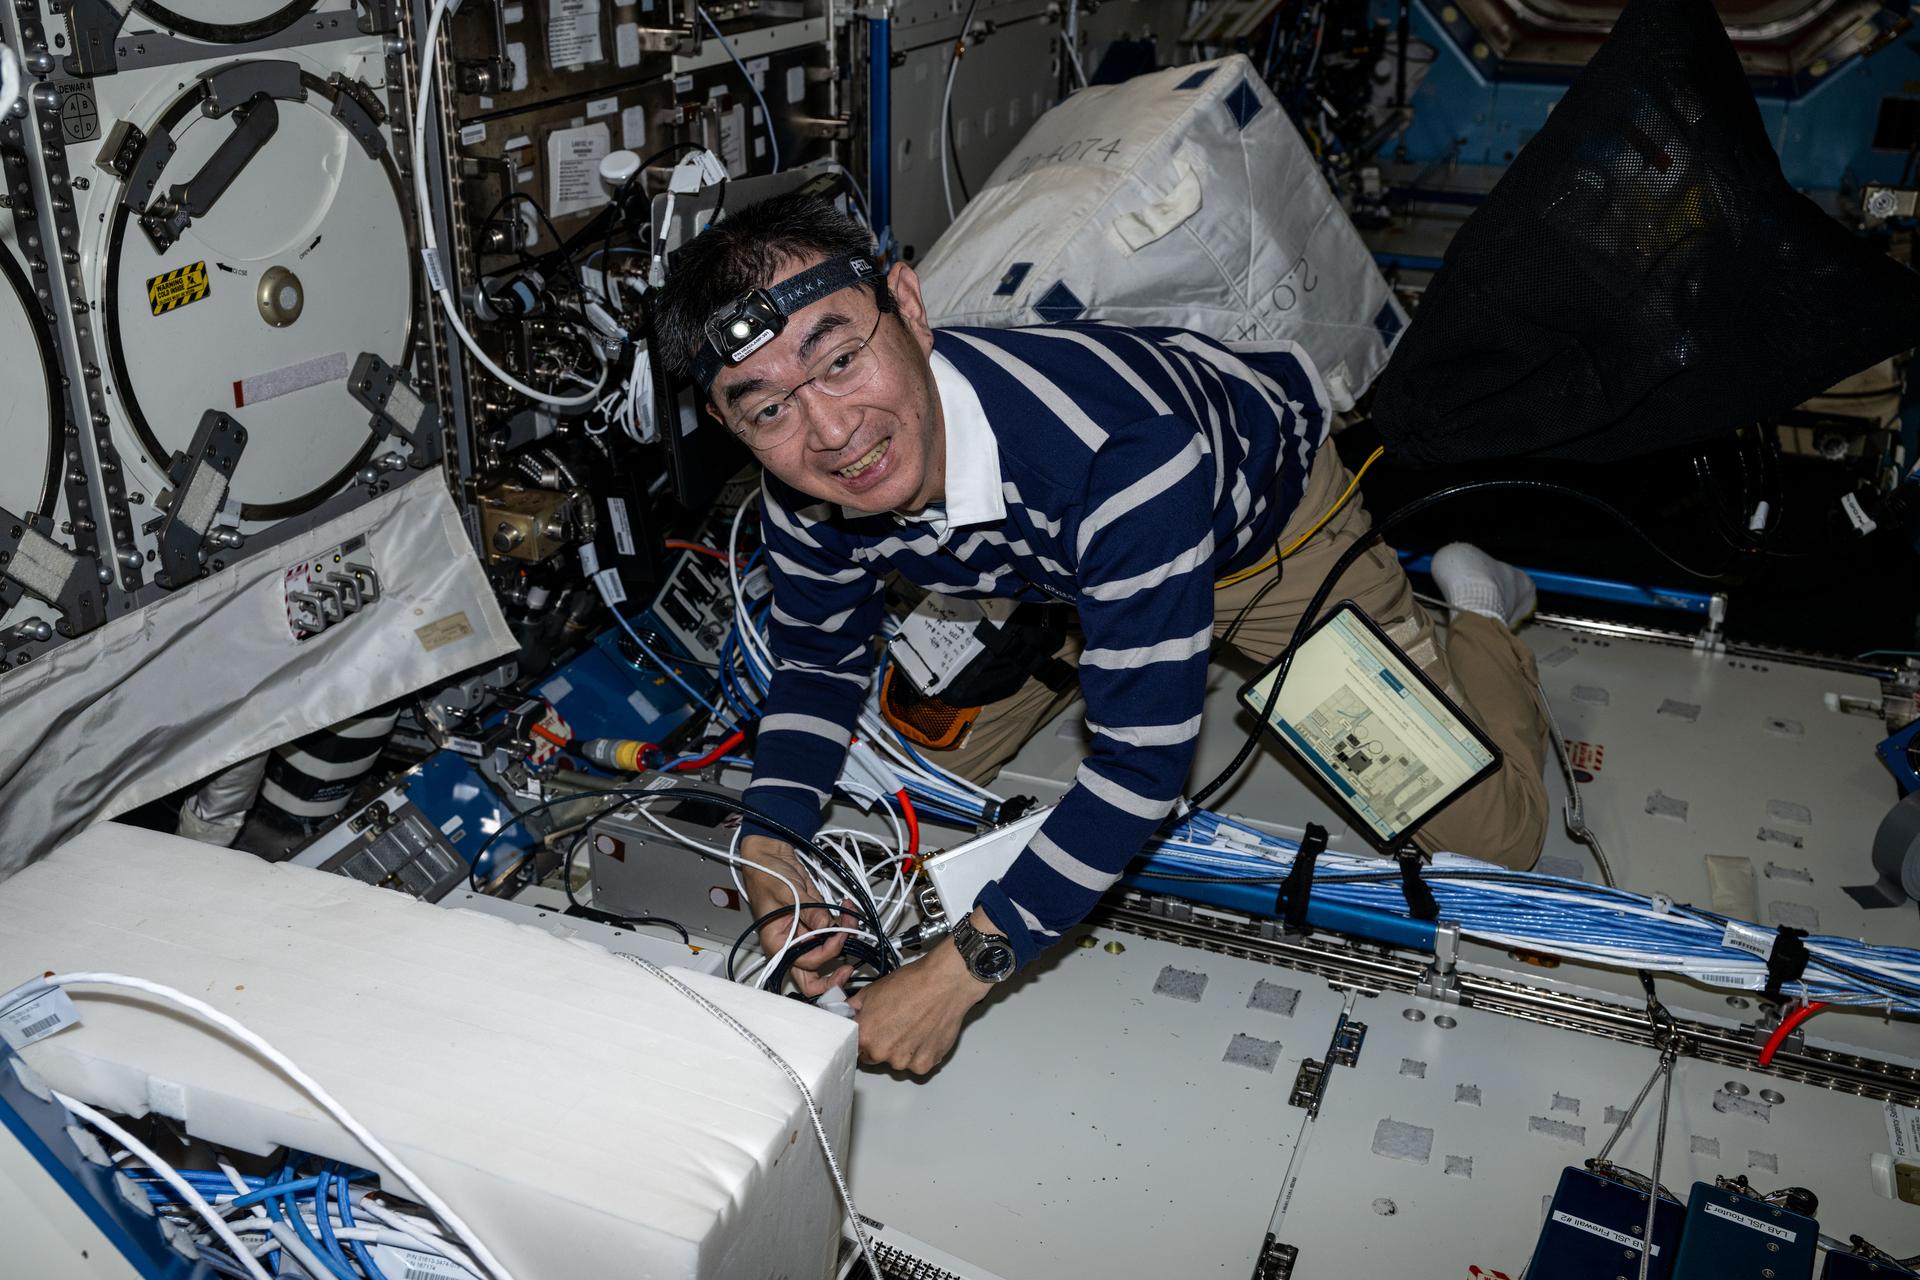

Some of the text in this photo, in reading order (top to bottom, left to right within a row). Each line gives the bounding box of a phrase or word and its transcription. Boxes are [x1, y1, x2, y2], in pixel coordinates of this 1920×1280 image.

[58, 82, 86, 94] DEWAR
[70, 100, 88, 111] A B
[74, 122, 91, 133] C D
[156, 277, 184, 292] WARNING
[158, 284, 185, 298] COLD INSIDE
[777, 278, 825, 306] TIKKA
[1893, 1119, 1904, 1147] Emergency
[1560, 1214, 1573, 1223] #2
[1713, 1207, 1744, 1223] Router
[1574, 1217, 1610, 1237] Firewall
[1748, 1219, 1766, 1229] JSL
[1613, 1232, 1631, 1243] JSL
[1767, 1226, 1788, 1238] LAB
